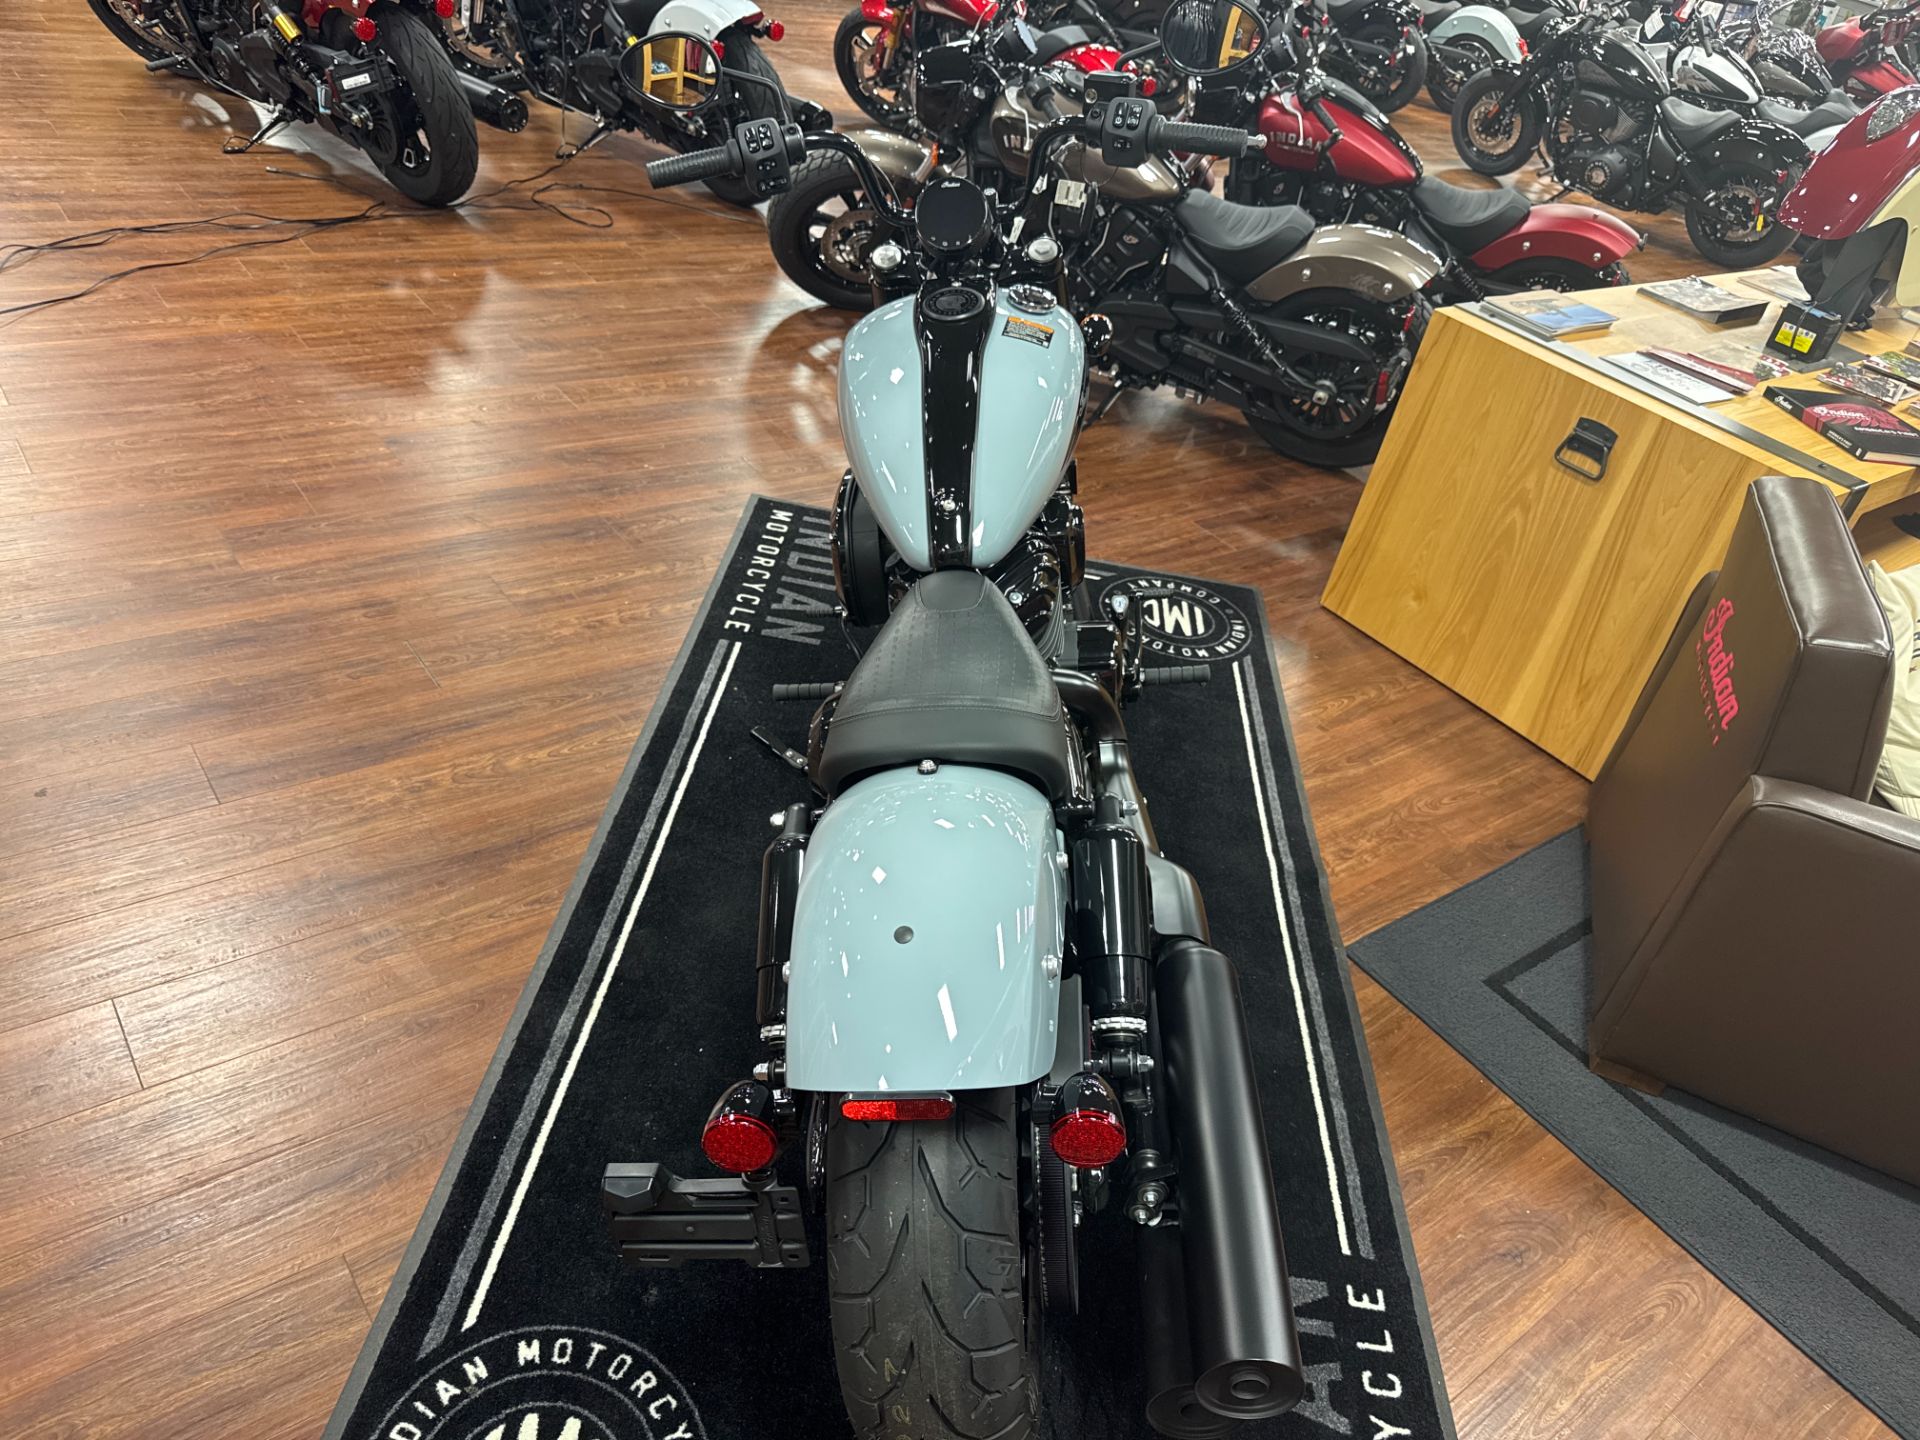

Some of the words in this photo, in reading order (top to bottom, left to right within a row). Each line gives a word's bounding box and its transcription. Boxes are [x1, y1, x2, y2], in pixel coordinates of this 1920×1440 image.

[1269, 131, 1323, 153] INDAN
[724, 509, 794, 632] MOTORCYCLE
[761, 515, 836, 646] INDIAN
[1143, 598, 1205, 637] IMC
[1215, 619, 1246, 655] INDIAN
[1704, 597, 1739, 731] Indian
